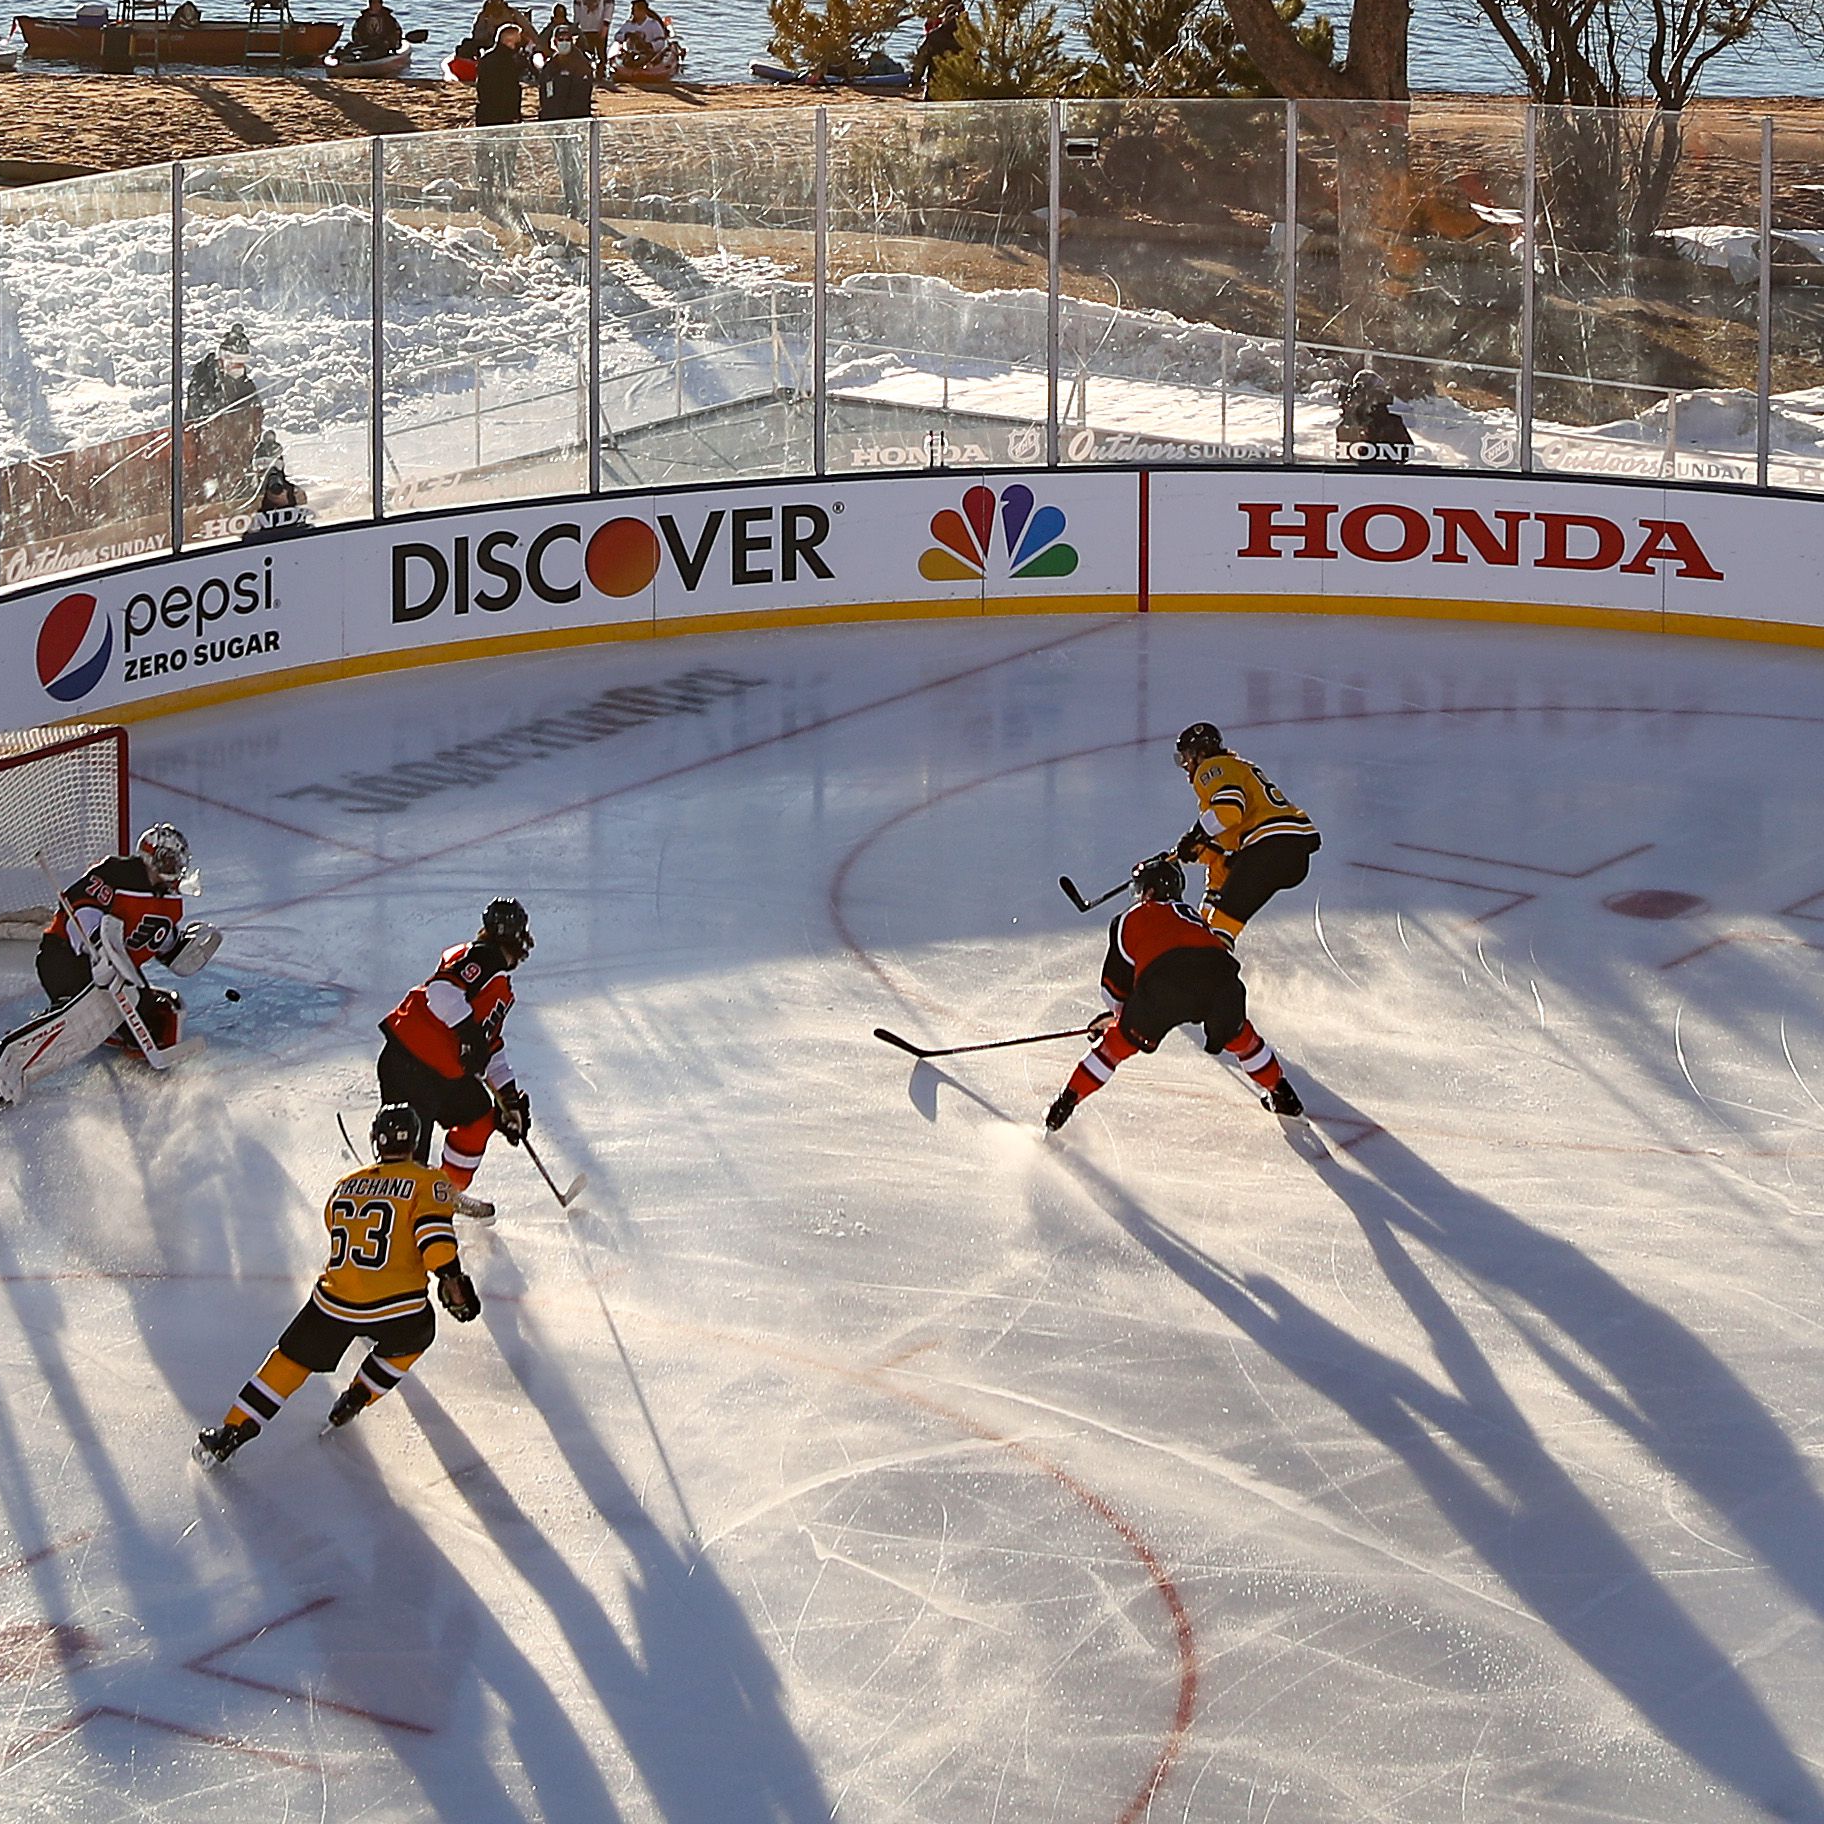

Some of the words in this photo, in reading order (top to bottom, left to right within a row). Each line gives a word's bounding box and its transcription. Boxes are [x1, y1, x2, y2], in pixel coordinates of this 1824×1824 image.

[1068, 428, 1187, 463] Outdoors
[1188, 444, 1272, 459] SUNDAY
[1321, 440, 1457, 462] HONDA
[1542, 439, 1662, 475] Outdoors
[1660, 460, 1749, 480] SUNDAY
[5, 542, 98, 586] Outdoors
[98, 533, 168, 562] SUNDAY
[392, 504, 836, 625] DISCOVER
[1237, 502, 1725, 582] HONDA
[124, 556, 274, 653] pepsi
[124, 642, 188, 683] ZERO
[193, 630, 281, 668] SUGAR
[85, 874, 114, 906] 79
[20, 1018, 67, 1047] TRUE
[329, 1198, 396, 1271] 63
